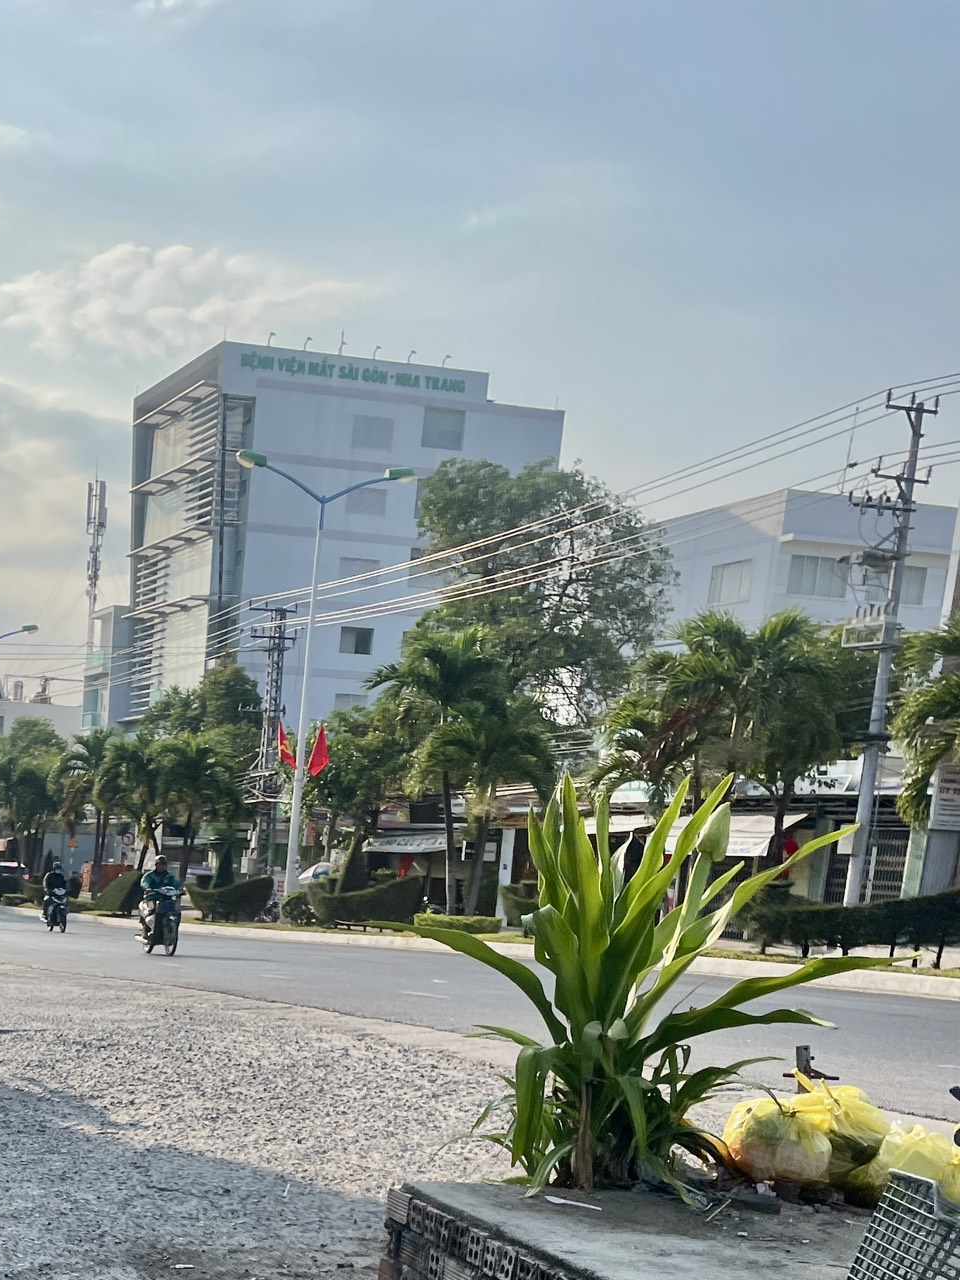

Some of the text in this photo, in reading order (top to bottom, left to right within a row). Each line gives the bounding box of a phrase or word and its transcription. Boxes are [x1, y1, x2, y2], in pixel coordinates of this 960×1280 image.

[240, 351, 274, 371] BỆNH
[278, 356, 305, 376] VIỆN
[425, 376, 466, 393] TRANG
